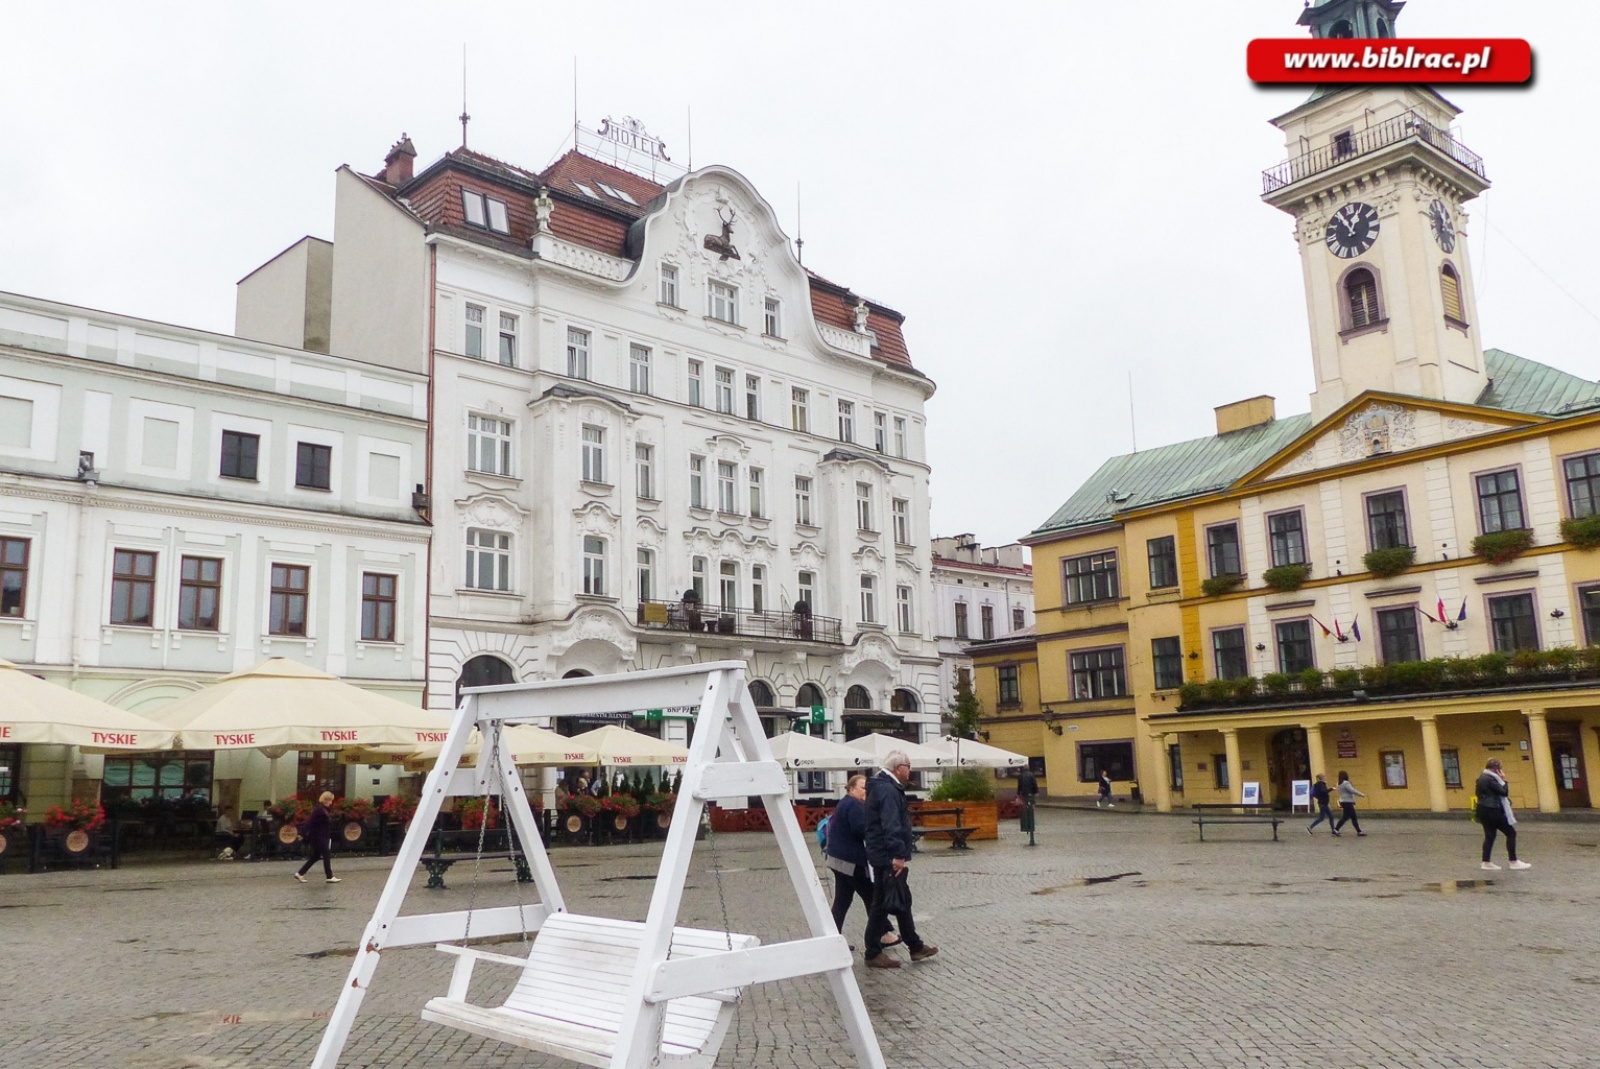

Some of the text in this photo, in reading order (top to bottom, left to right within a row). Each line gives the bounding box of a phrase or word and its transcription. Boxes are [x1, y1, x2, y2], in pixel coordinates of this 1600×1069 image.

[610, 124, 659, 158] HOTEL
[92, 732, 138, 745] TYSKIE
[214, 733, 256, 745] TYSKIE
[320, 730, 358, 741] TYSKIE
[564, 753, 584, 761] TYSKIE
